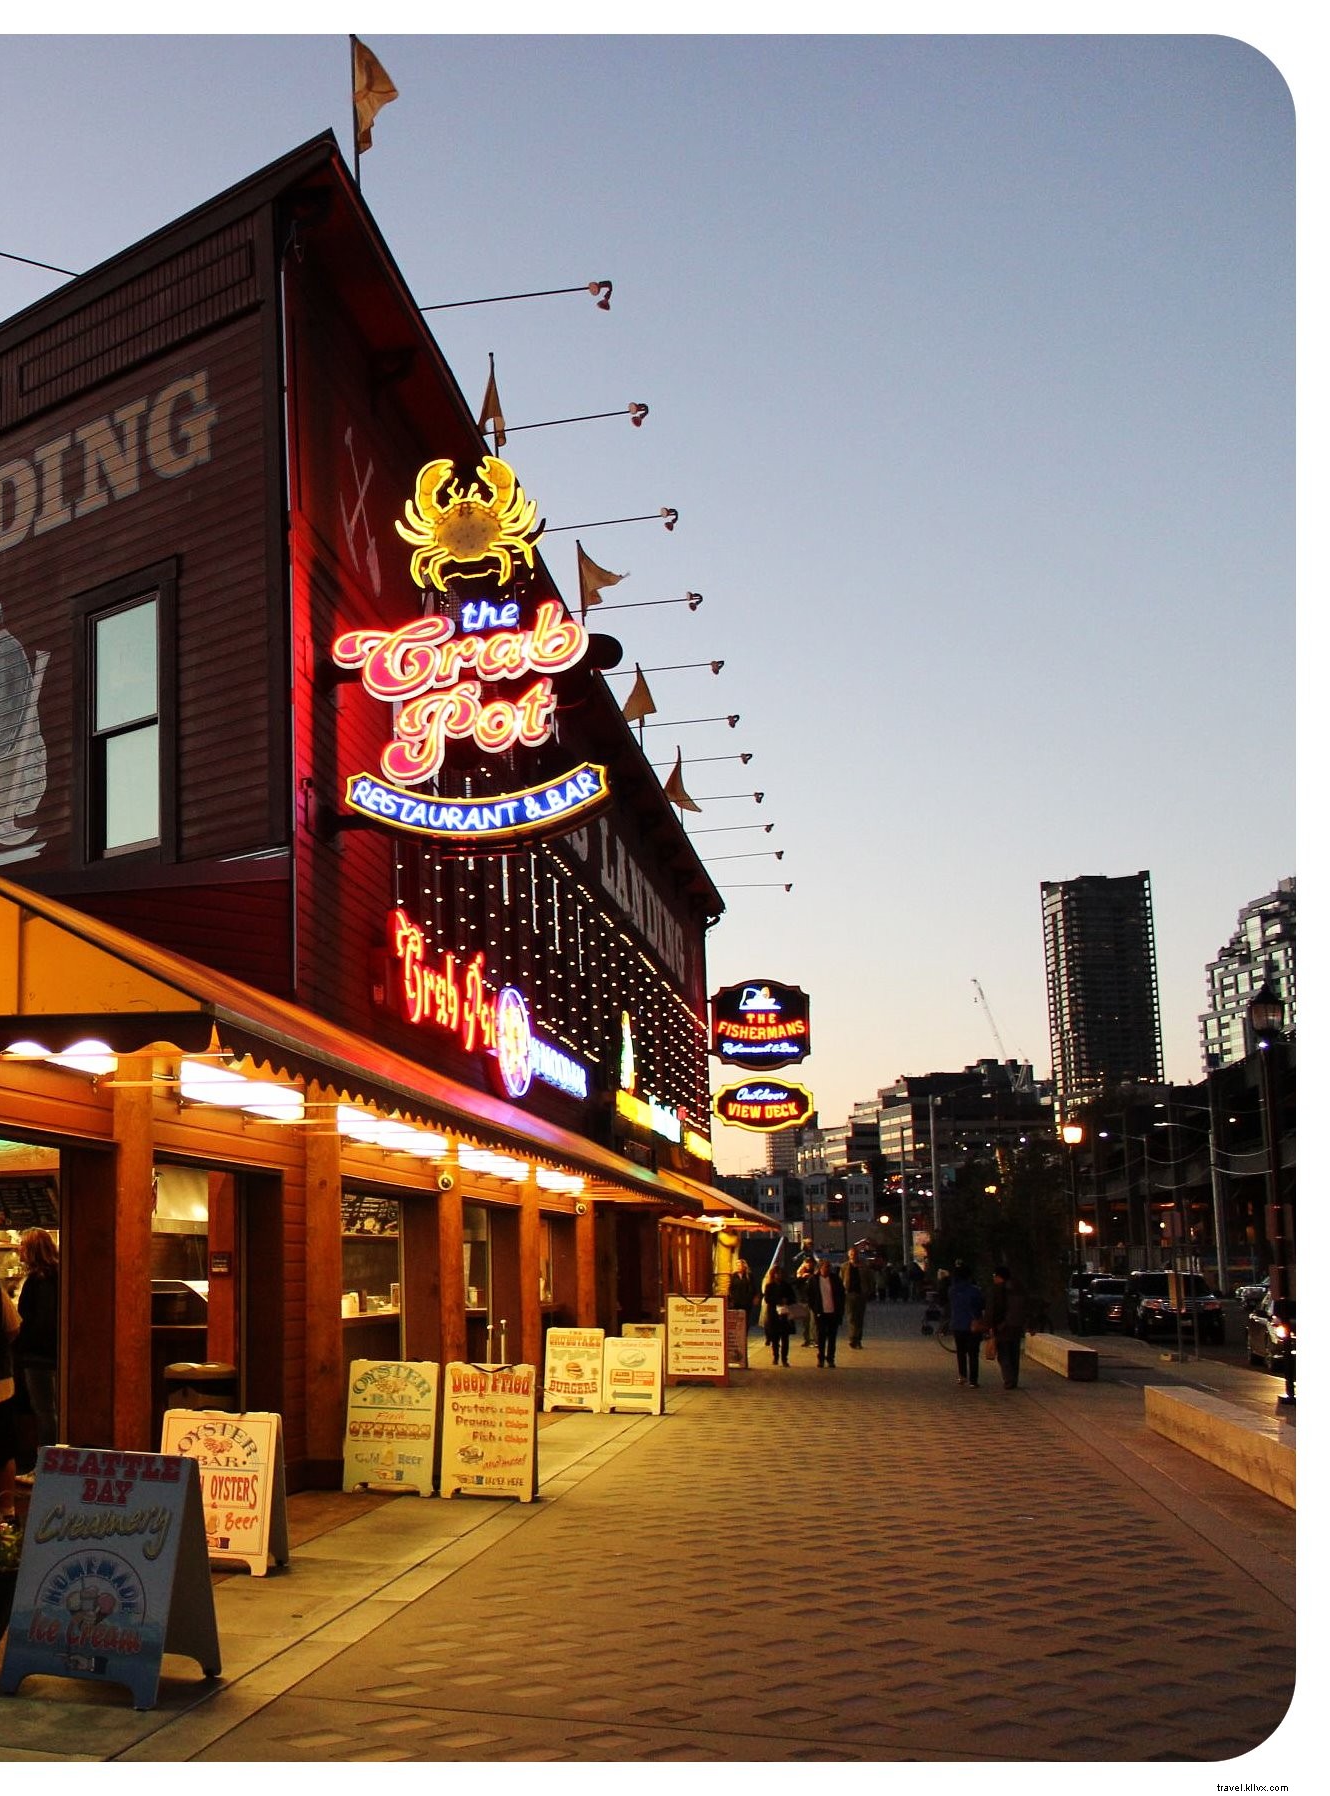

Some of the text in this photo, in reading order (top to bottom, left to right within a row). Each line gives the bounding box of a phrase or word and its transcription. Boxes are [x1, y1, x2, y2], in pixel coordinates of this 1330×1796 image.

[461, 600, 520, 632] the
[332, 600, 589, 702] Crab
[381, 677, 557, 785] Pot
[351, 773, 600, 831] RESTAURANT & BAR
[599, 817, 685, 984] LANDING
[717, 1020, 806, 1040] FISHERMANS
[745, 1013, 777, 1024] THE
[736, 1088, 788, 1101] Outdoor
[728, 1102, 799, 1118] VIEW DECK
[352, 1364, 431, 1399] OYSTER
[450, 1368, 532, 1398] Deep Fried
[548, 1380, 598, 1395] BURGERS
[451, 1402, 497, 1414] Oysters
[177, 1422, 258, 1457] OYSTER
[350, 1421, 431, 1440] OYSTERS
[472, 1431, 496, 1442] Fish
[42, 1449, 183, 1482] SEATTLE
[197, 1456, 239, 1467] BAR
[82, 1479, 134, 1506] BAY
[210, 1474, 259, 1509] OYSTERS
[34, 1504, 172, 1560] Creamery
[224, 1512, 259, 1531] Beer
[27, 1606, 143, 1655] Ice Cream
